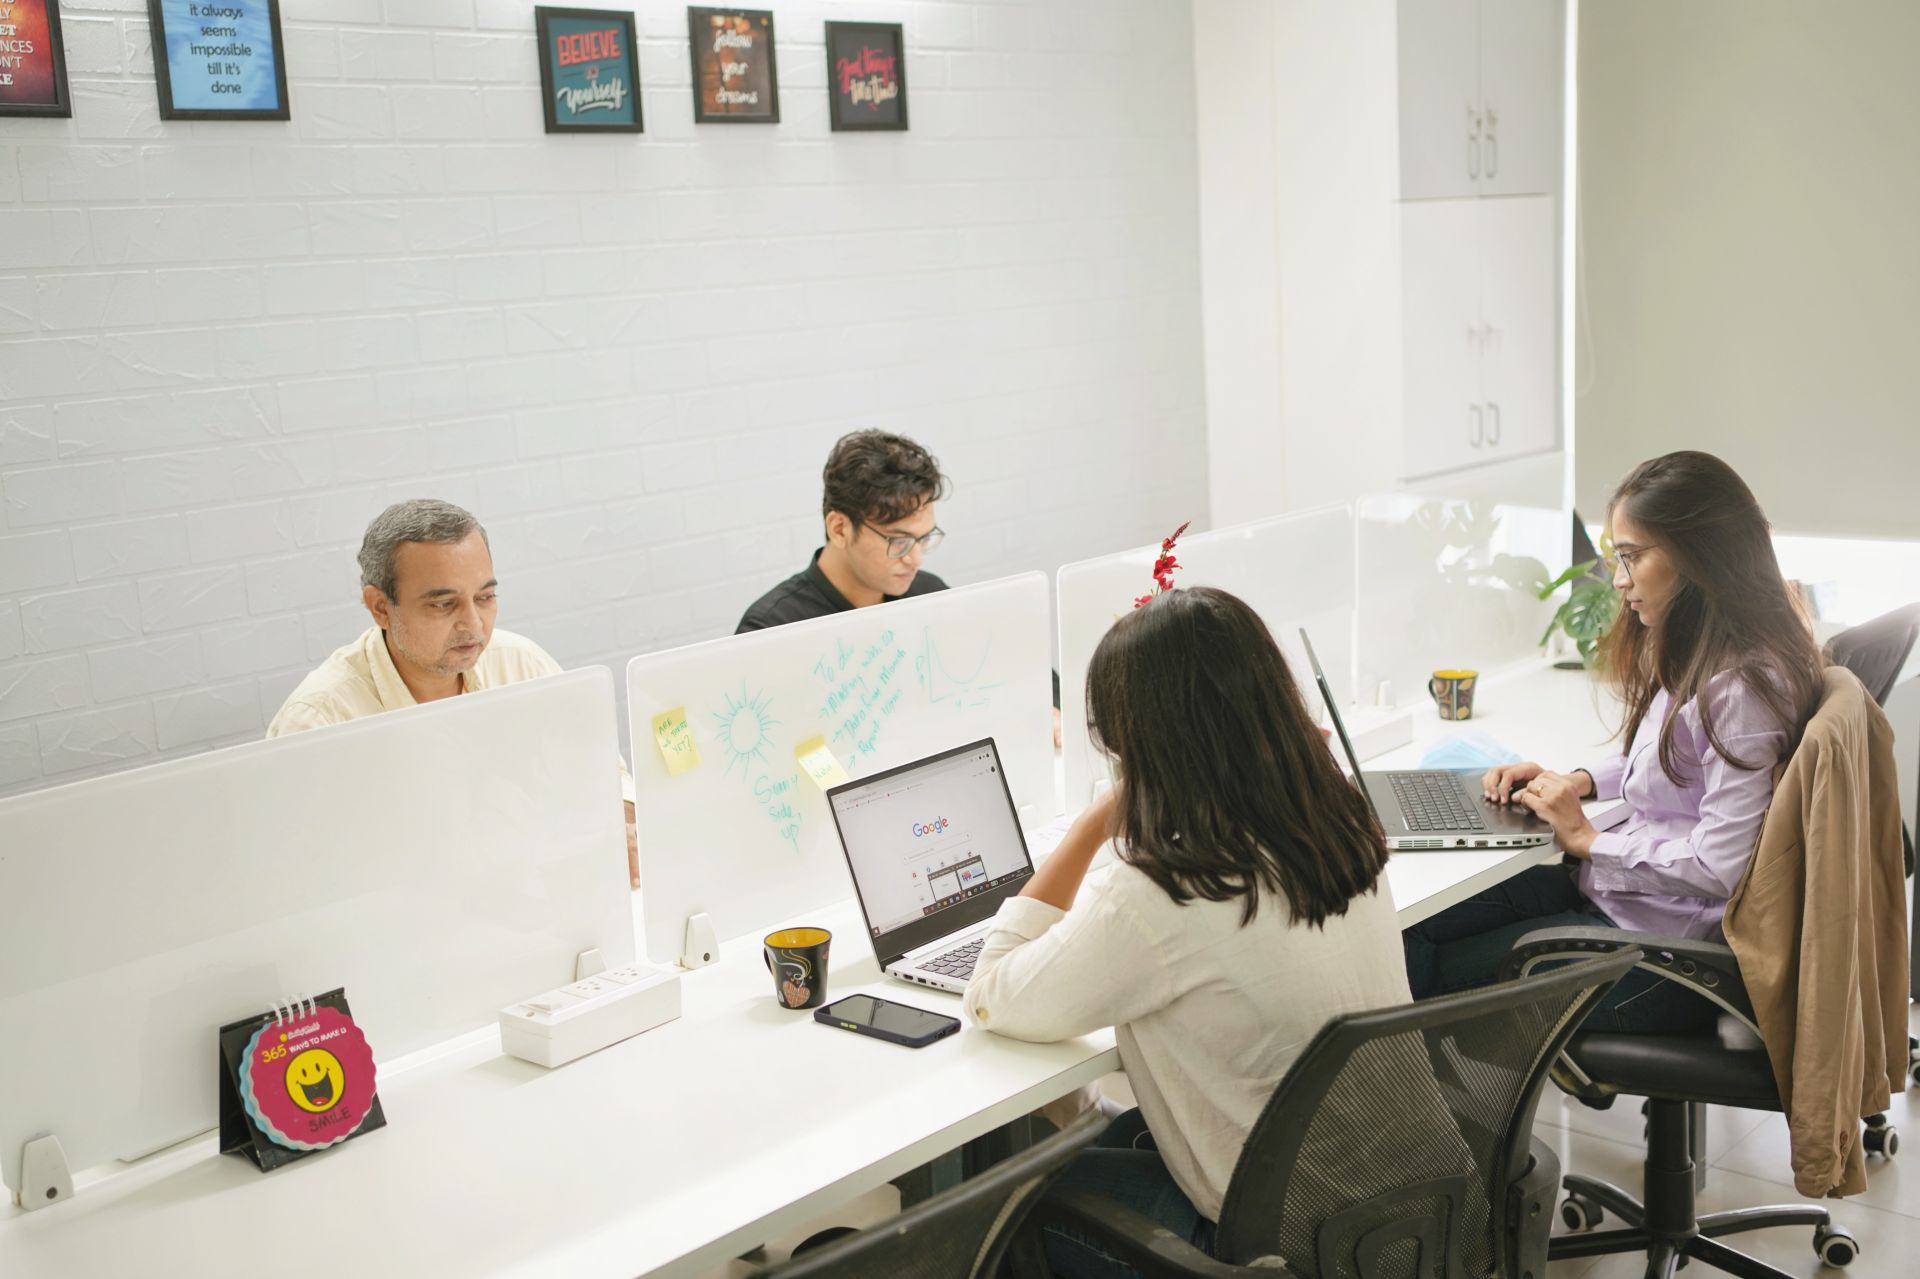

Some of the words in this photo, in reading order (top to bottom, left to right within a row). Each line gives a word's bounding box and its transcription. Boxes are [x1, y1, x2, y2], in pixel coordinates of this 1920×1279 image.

[190, 4, 198, 16] it
[201, 4, 243, 20] always
[201, 26, 237, 37] seems
[0, 39, 34, 54] NCES
[190, 42, 252, 58] impossible
[557, 28, 622, 67] BELIEVE
[208, 62, 222, 75] till
[225, 62, 241, 76] it's
[211, 80, 242, 94] done
[658, 718, 672, 736] ARE
[912, 816, 950, 838] Google
[261, 1043, 287, 1064] 365
[289, 1040, 310, 1053] WAYS
[309, 1036, 320, 1045] TO
[320, 1029, 340, 1041] MAKE
[308, 1107, 351, 1133] SMILE
